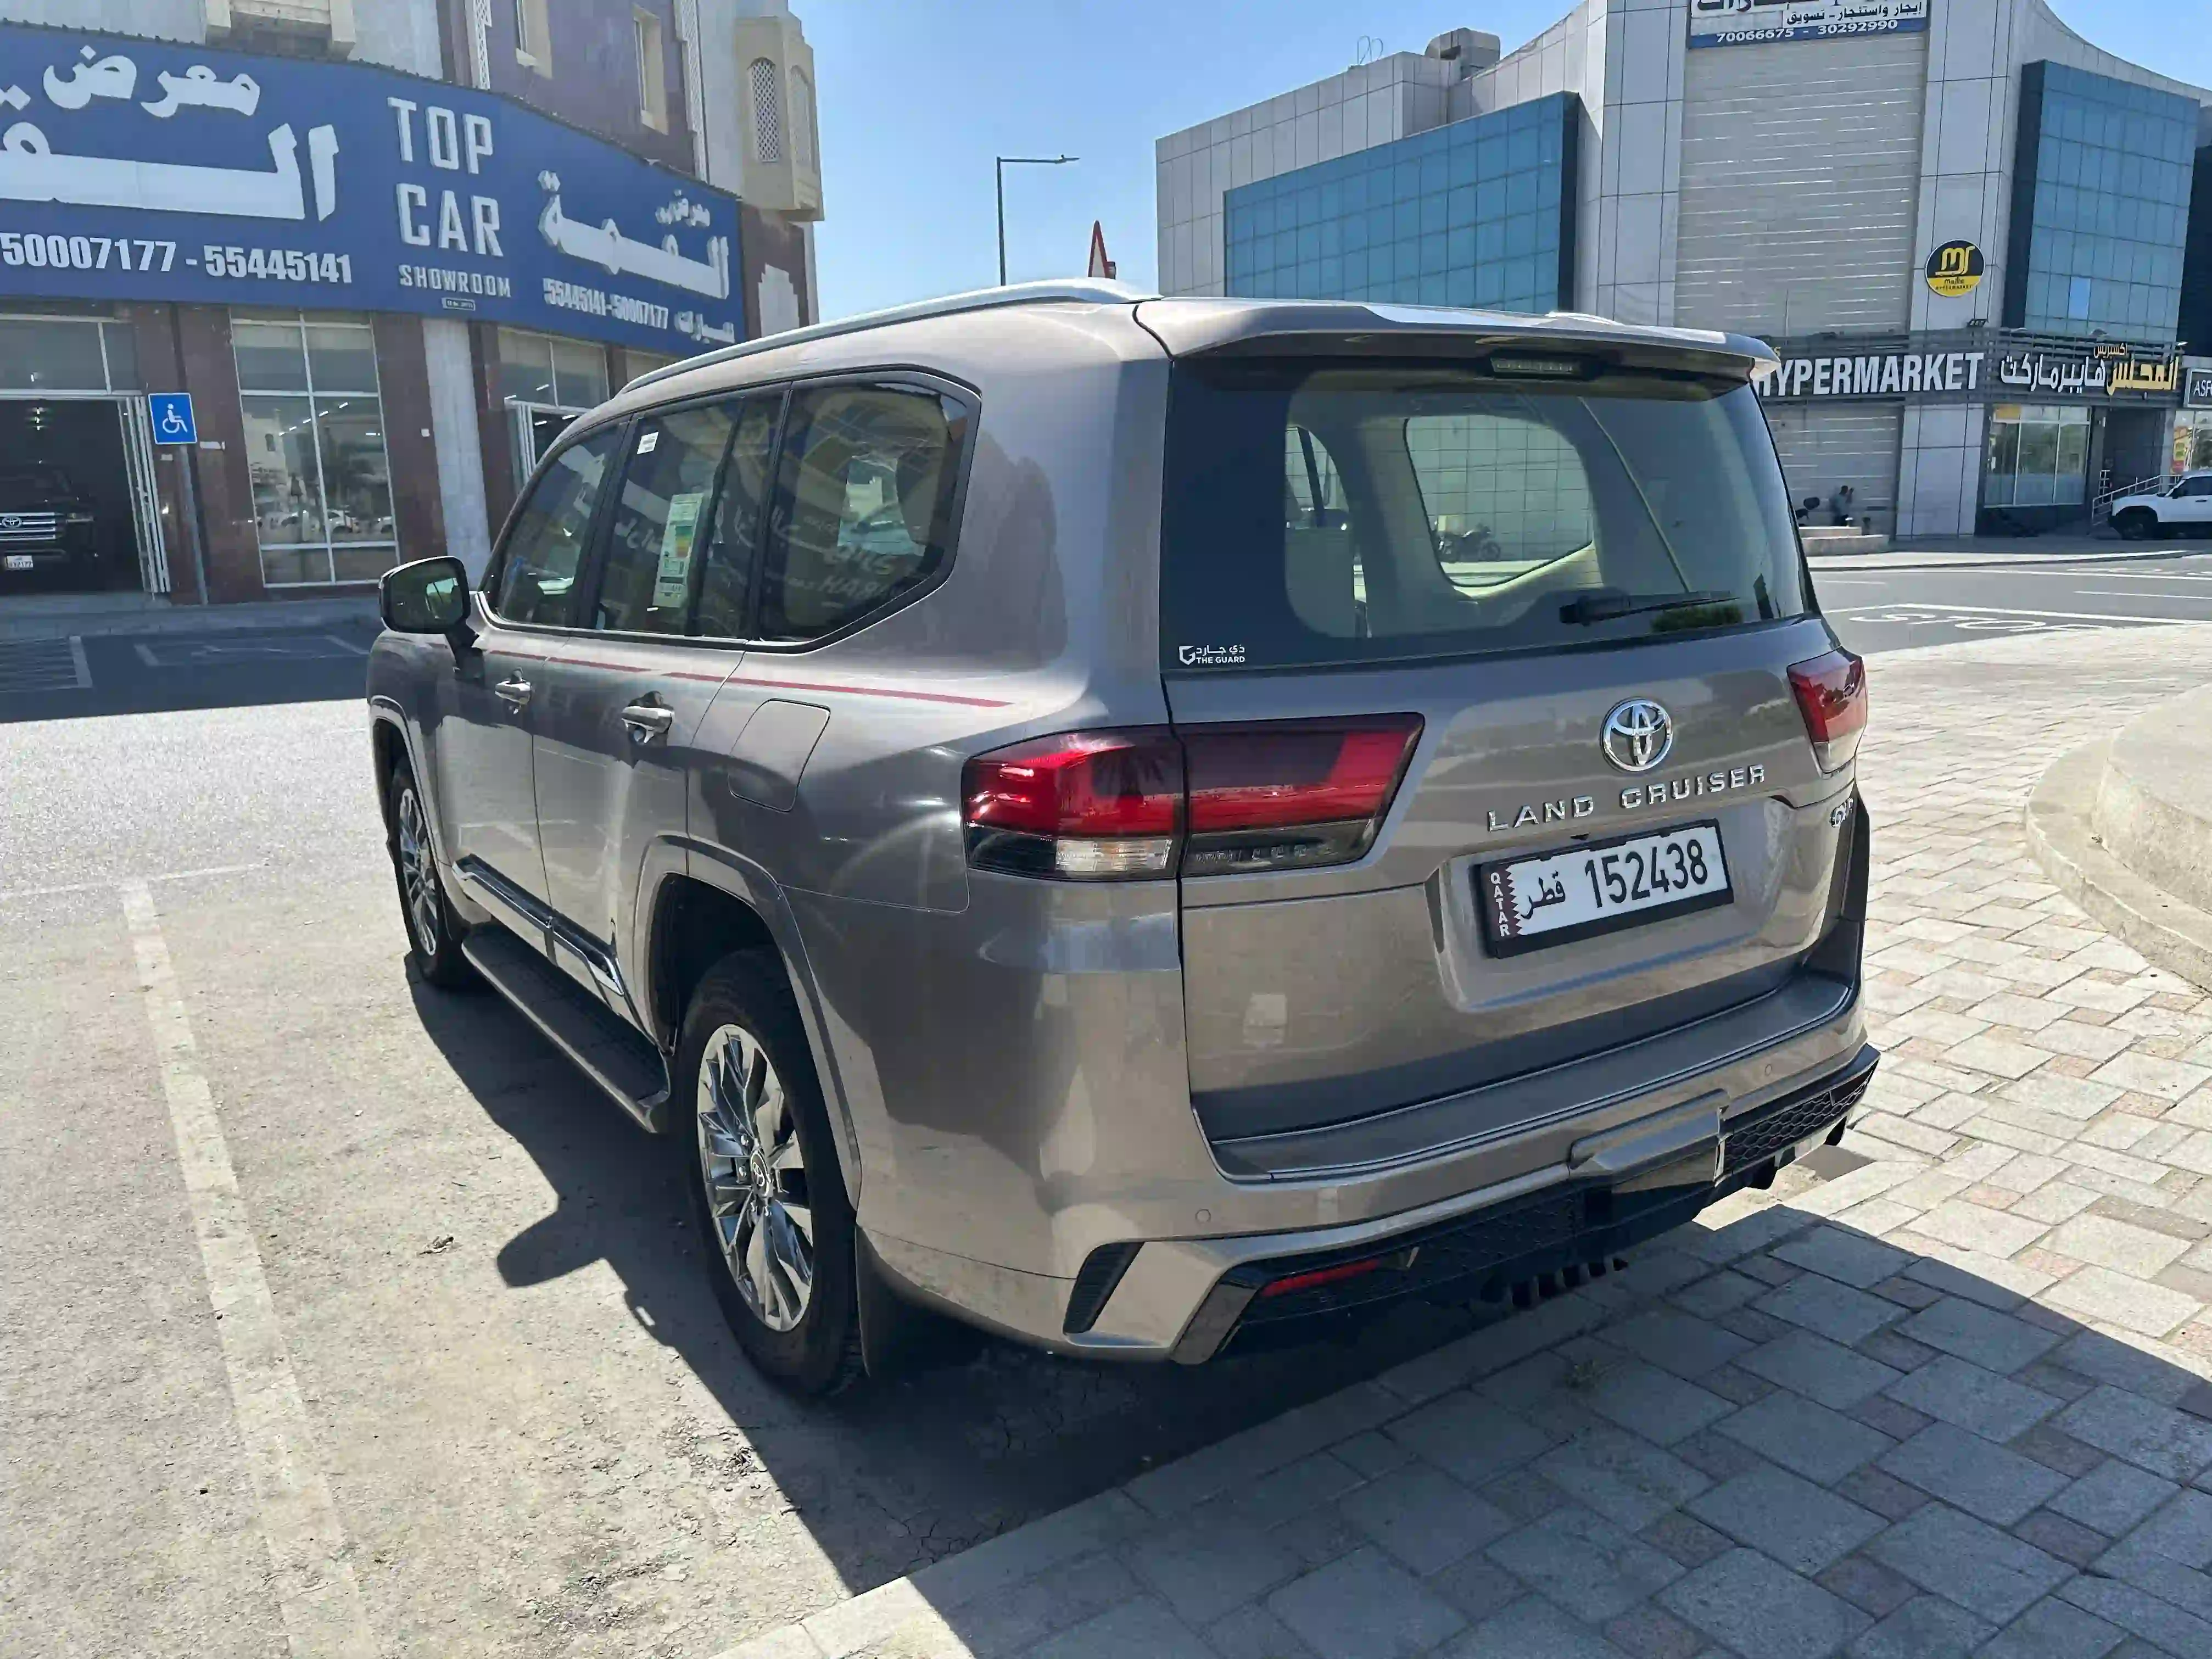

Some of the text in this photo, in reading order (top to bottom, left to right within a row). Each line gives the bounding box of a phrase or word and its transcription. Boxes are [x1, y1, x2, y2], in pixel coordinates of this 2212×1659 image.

[1717, 28, 1795, 43] 70066675
[1817, 20, 1898, 35] 30292990
[43, 44, 260, 118] معرض
[387, 97, 493, 174] TOP
[396, 183, 504, 257] CAR
[0, 232, 176, 272] 50007177
[204, 245, 352, 283] 55445141
[398, 264, 511, 298] SHOWROOM
[1487, 764, 1765, 832] LAND CRUISER
[1490, 872, 1510, 937] QATAR
[1520, 872, 1566, 920] قطر
[1585, 839, 1708, 909] 152438
